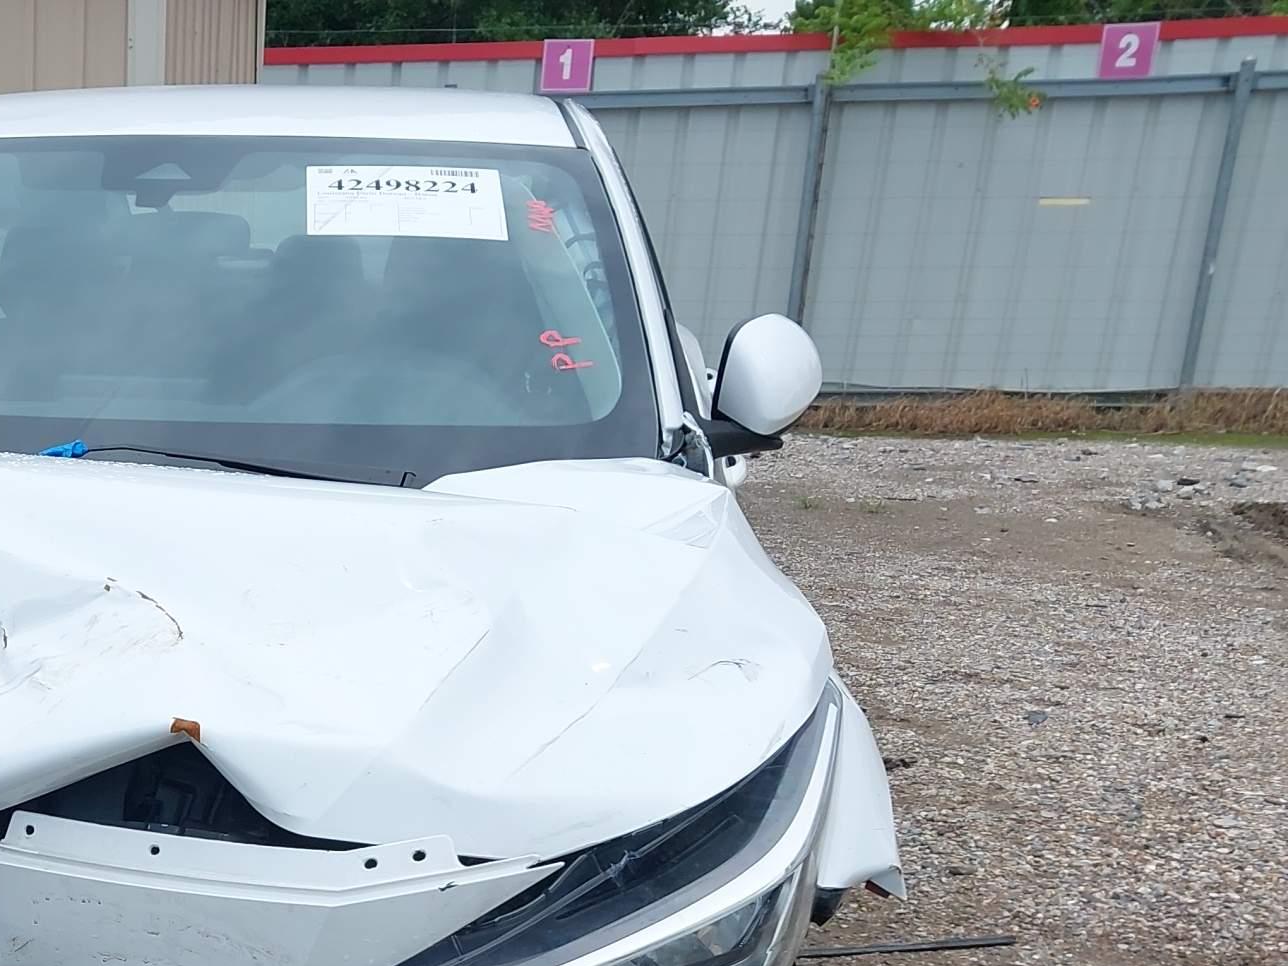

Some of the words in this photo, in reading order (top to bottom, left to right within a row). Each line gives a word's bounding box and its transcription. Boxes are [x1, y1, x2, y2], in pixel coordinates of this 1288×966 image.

[559, 48, 573, 80] 1
[1115, 33, 1140, 68] 2
[328, 178, 478, 194] 42498224
